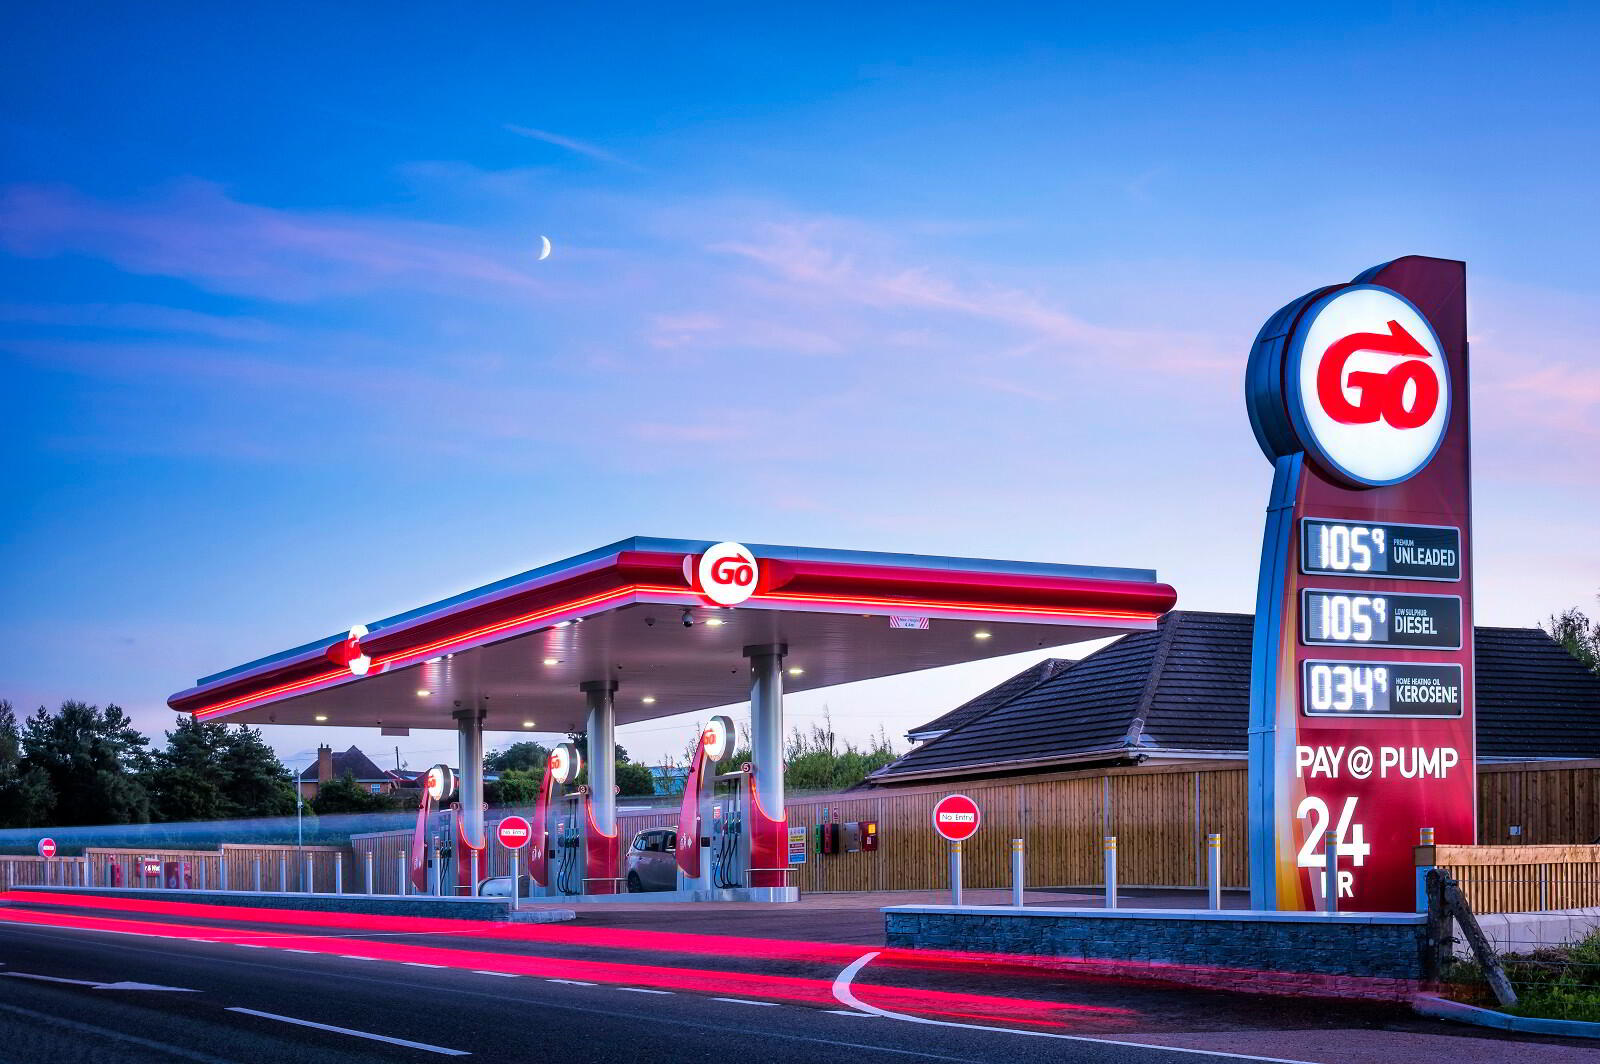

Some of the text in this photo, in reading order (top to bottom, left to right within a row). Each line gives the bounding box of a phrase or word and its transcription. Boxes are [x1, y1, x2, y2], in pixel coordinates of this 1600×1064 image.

[1393, 538, 1414, 547] PREMIUM
[1393, 547, 1456, 567] UNLEADED
[1394, 608, 1427, 617] LOW SULPHUR
[1394, 616, 1438, 635] DIESEL
[1395, 677, 1411, 685] HOME
[1411, 678, 1431, 686] HEATING
[1396, 685, 1458, 704] KEROSENE
[1296, 745, 1459, 780] PAY @ PUMP
[941, 813, 973, 821] No Entry
[1296, 796, 1371, 868] 24
